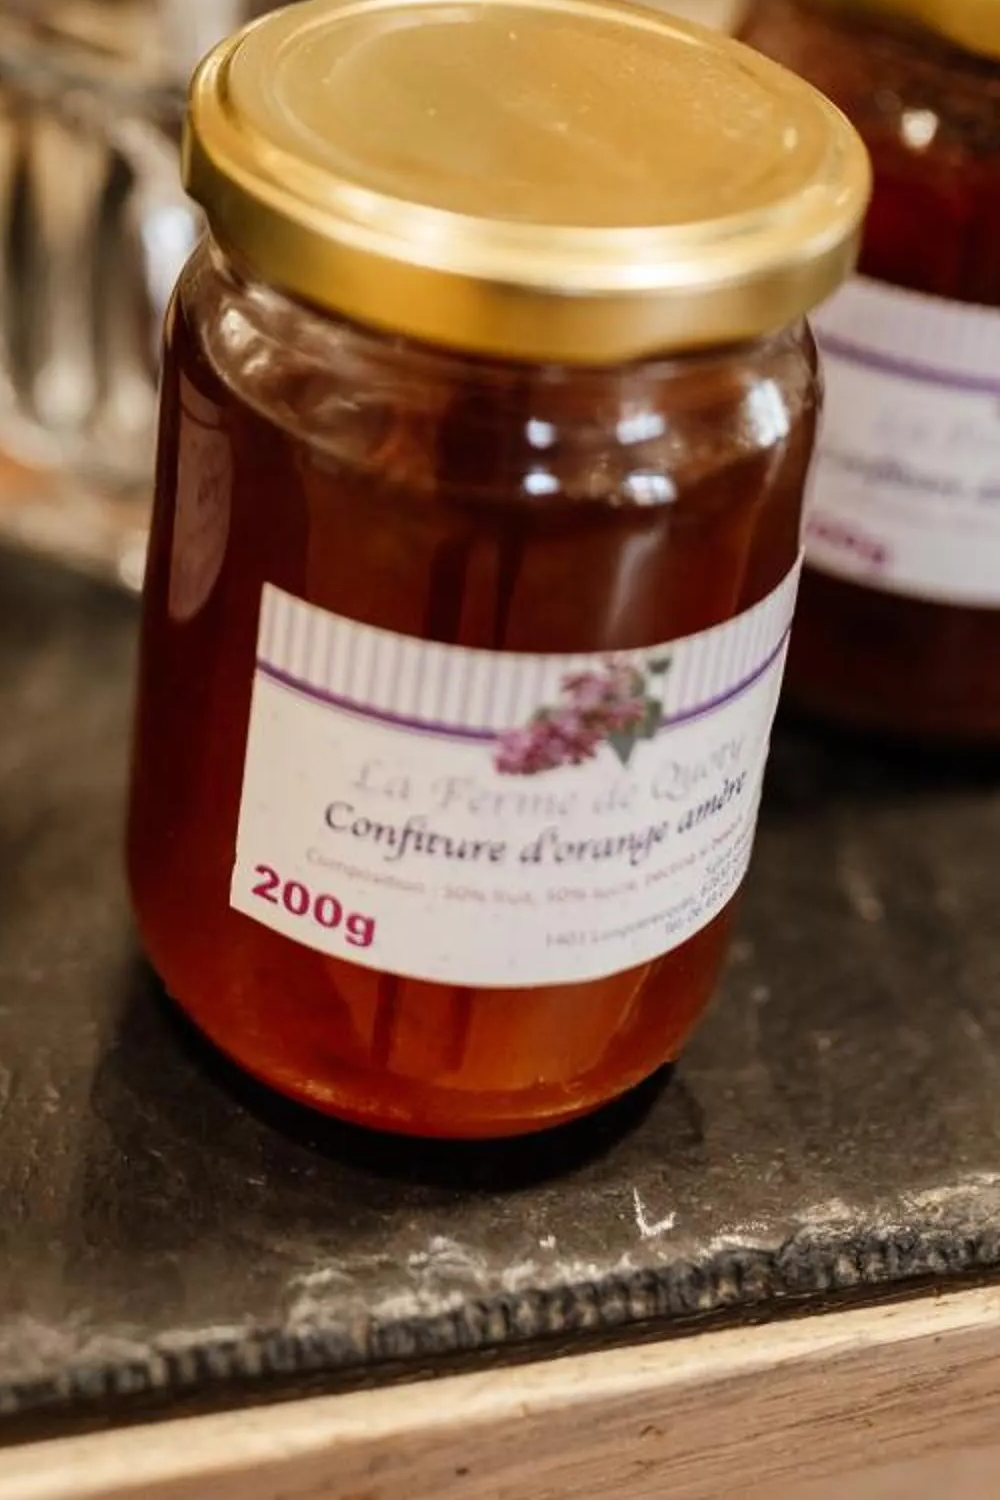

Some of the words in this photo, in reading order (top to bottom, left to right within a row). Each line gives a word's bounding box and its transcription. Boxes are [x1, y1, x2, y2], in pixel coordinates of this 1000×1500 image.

[323, 800, 507, 863] Confiture
[519, 819, 667, 867] d'orange
[251, 862, 377, 950] 200g
